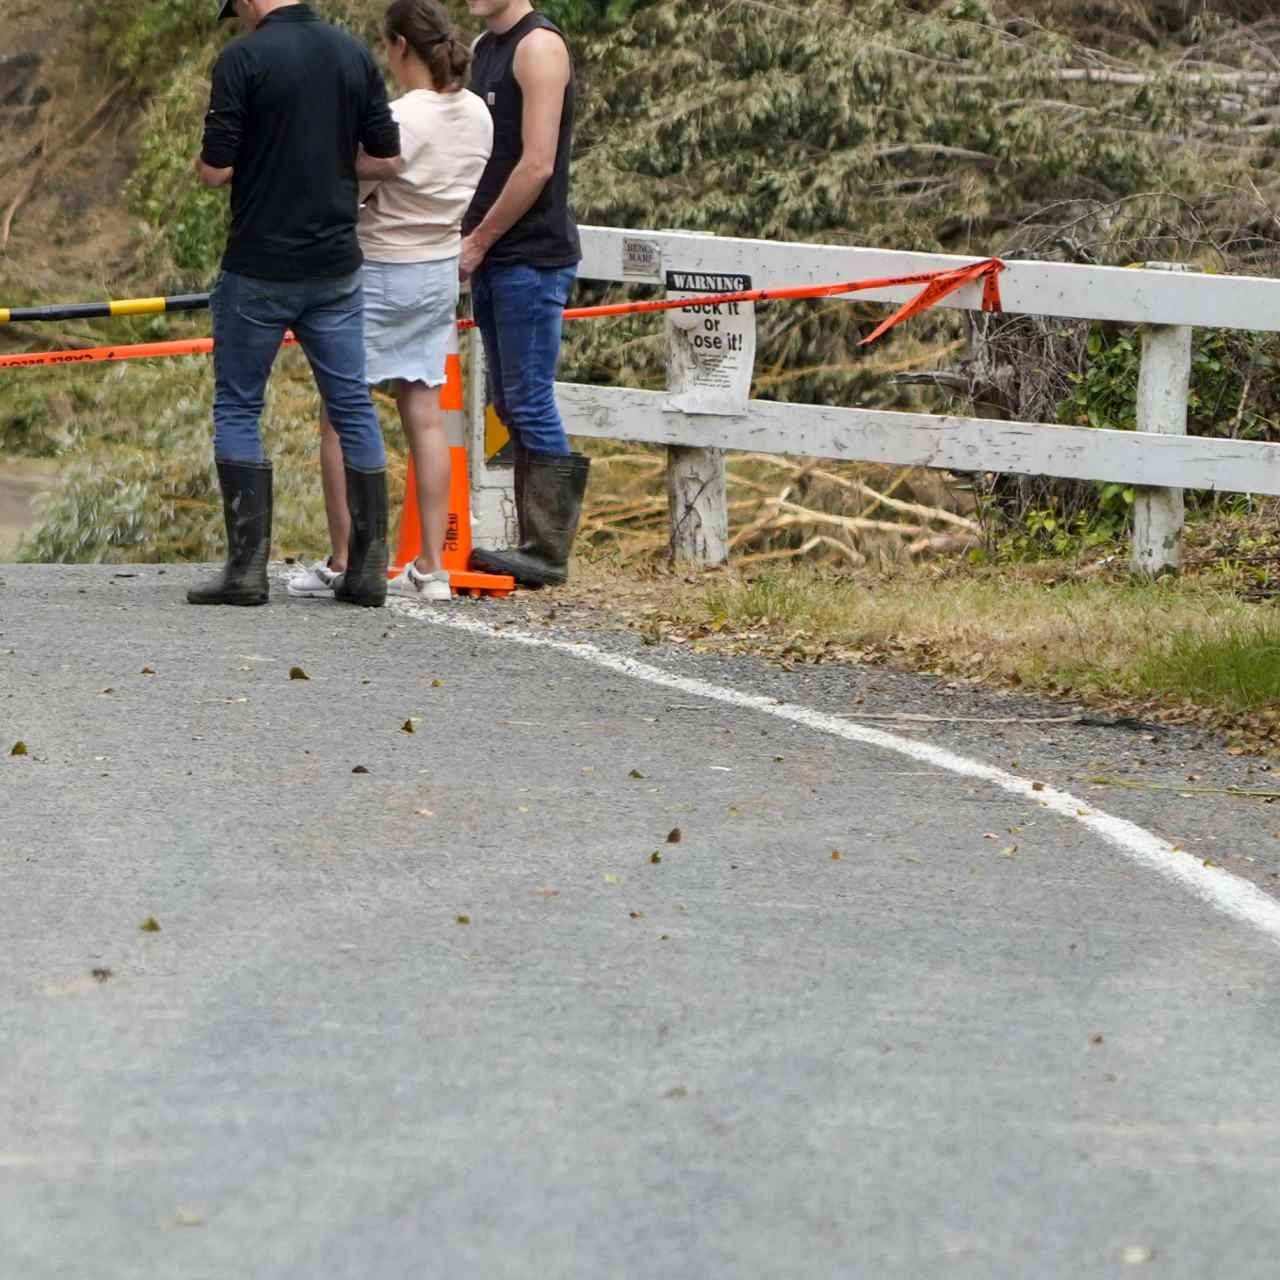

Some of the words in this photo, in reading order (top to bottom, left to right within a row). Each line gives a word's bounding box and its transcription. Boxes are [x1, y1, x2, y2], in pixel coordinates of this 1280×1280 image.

[672, 273, 744, 291] WARNING
[704, 318, 720, 331] or
[692, 334, 722, 350] ose
[727, 331, 743, 352] it!
